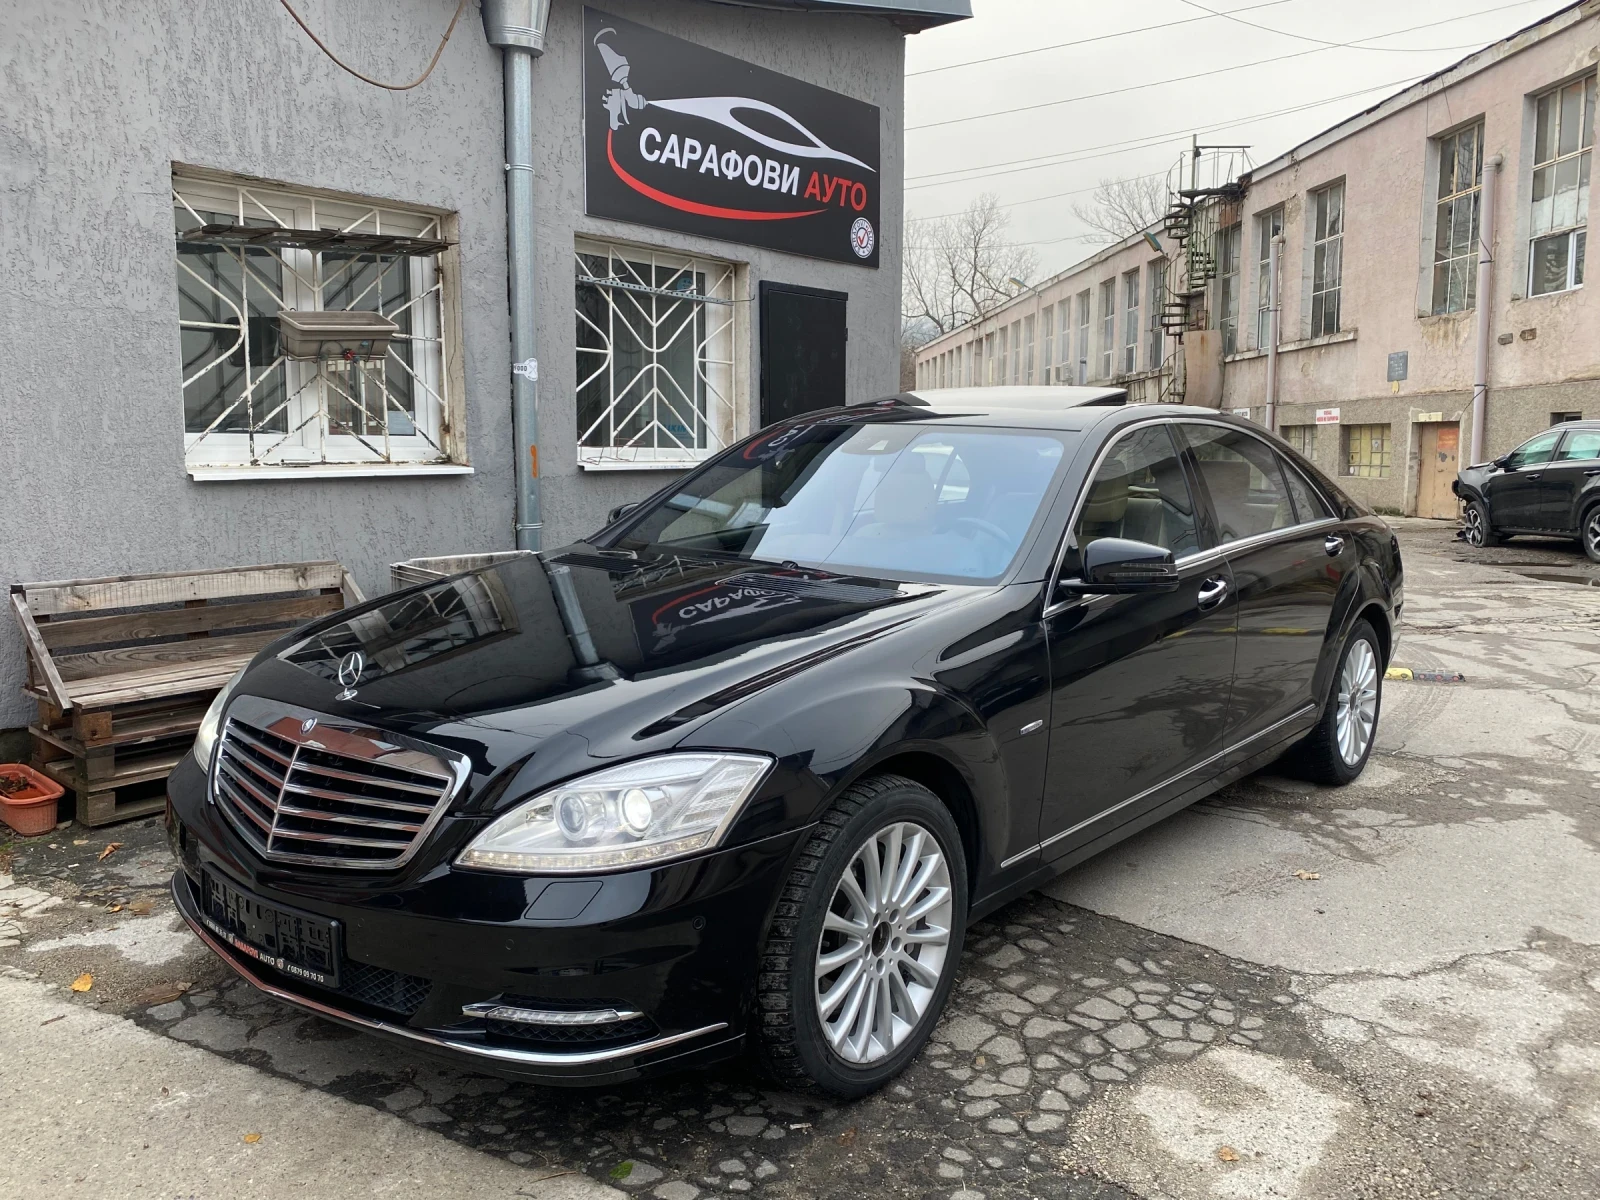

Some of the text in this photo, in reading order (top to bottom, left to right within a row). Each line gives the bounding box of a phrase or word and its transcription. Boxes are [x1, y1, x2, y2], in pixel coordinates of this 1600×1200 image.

[639, 127, 867, 211] САРАФОВИ АУТО
[259, 952, 275, 966] AUTO
